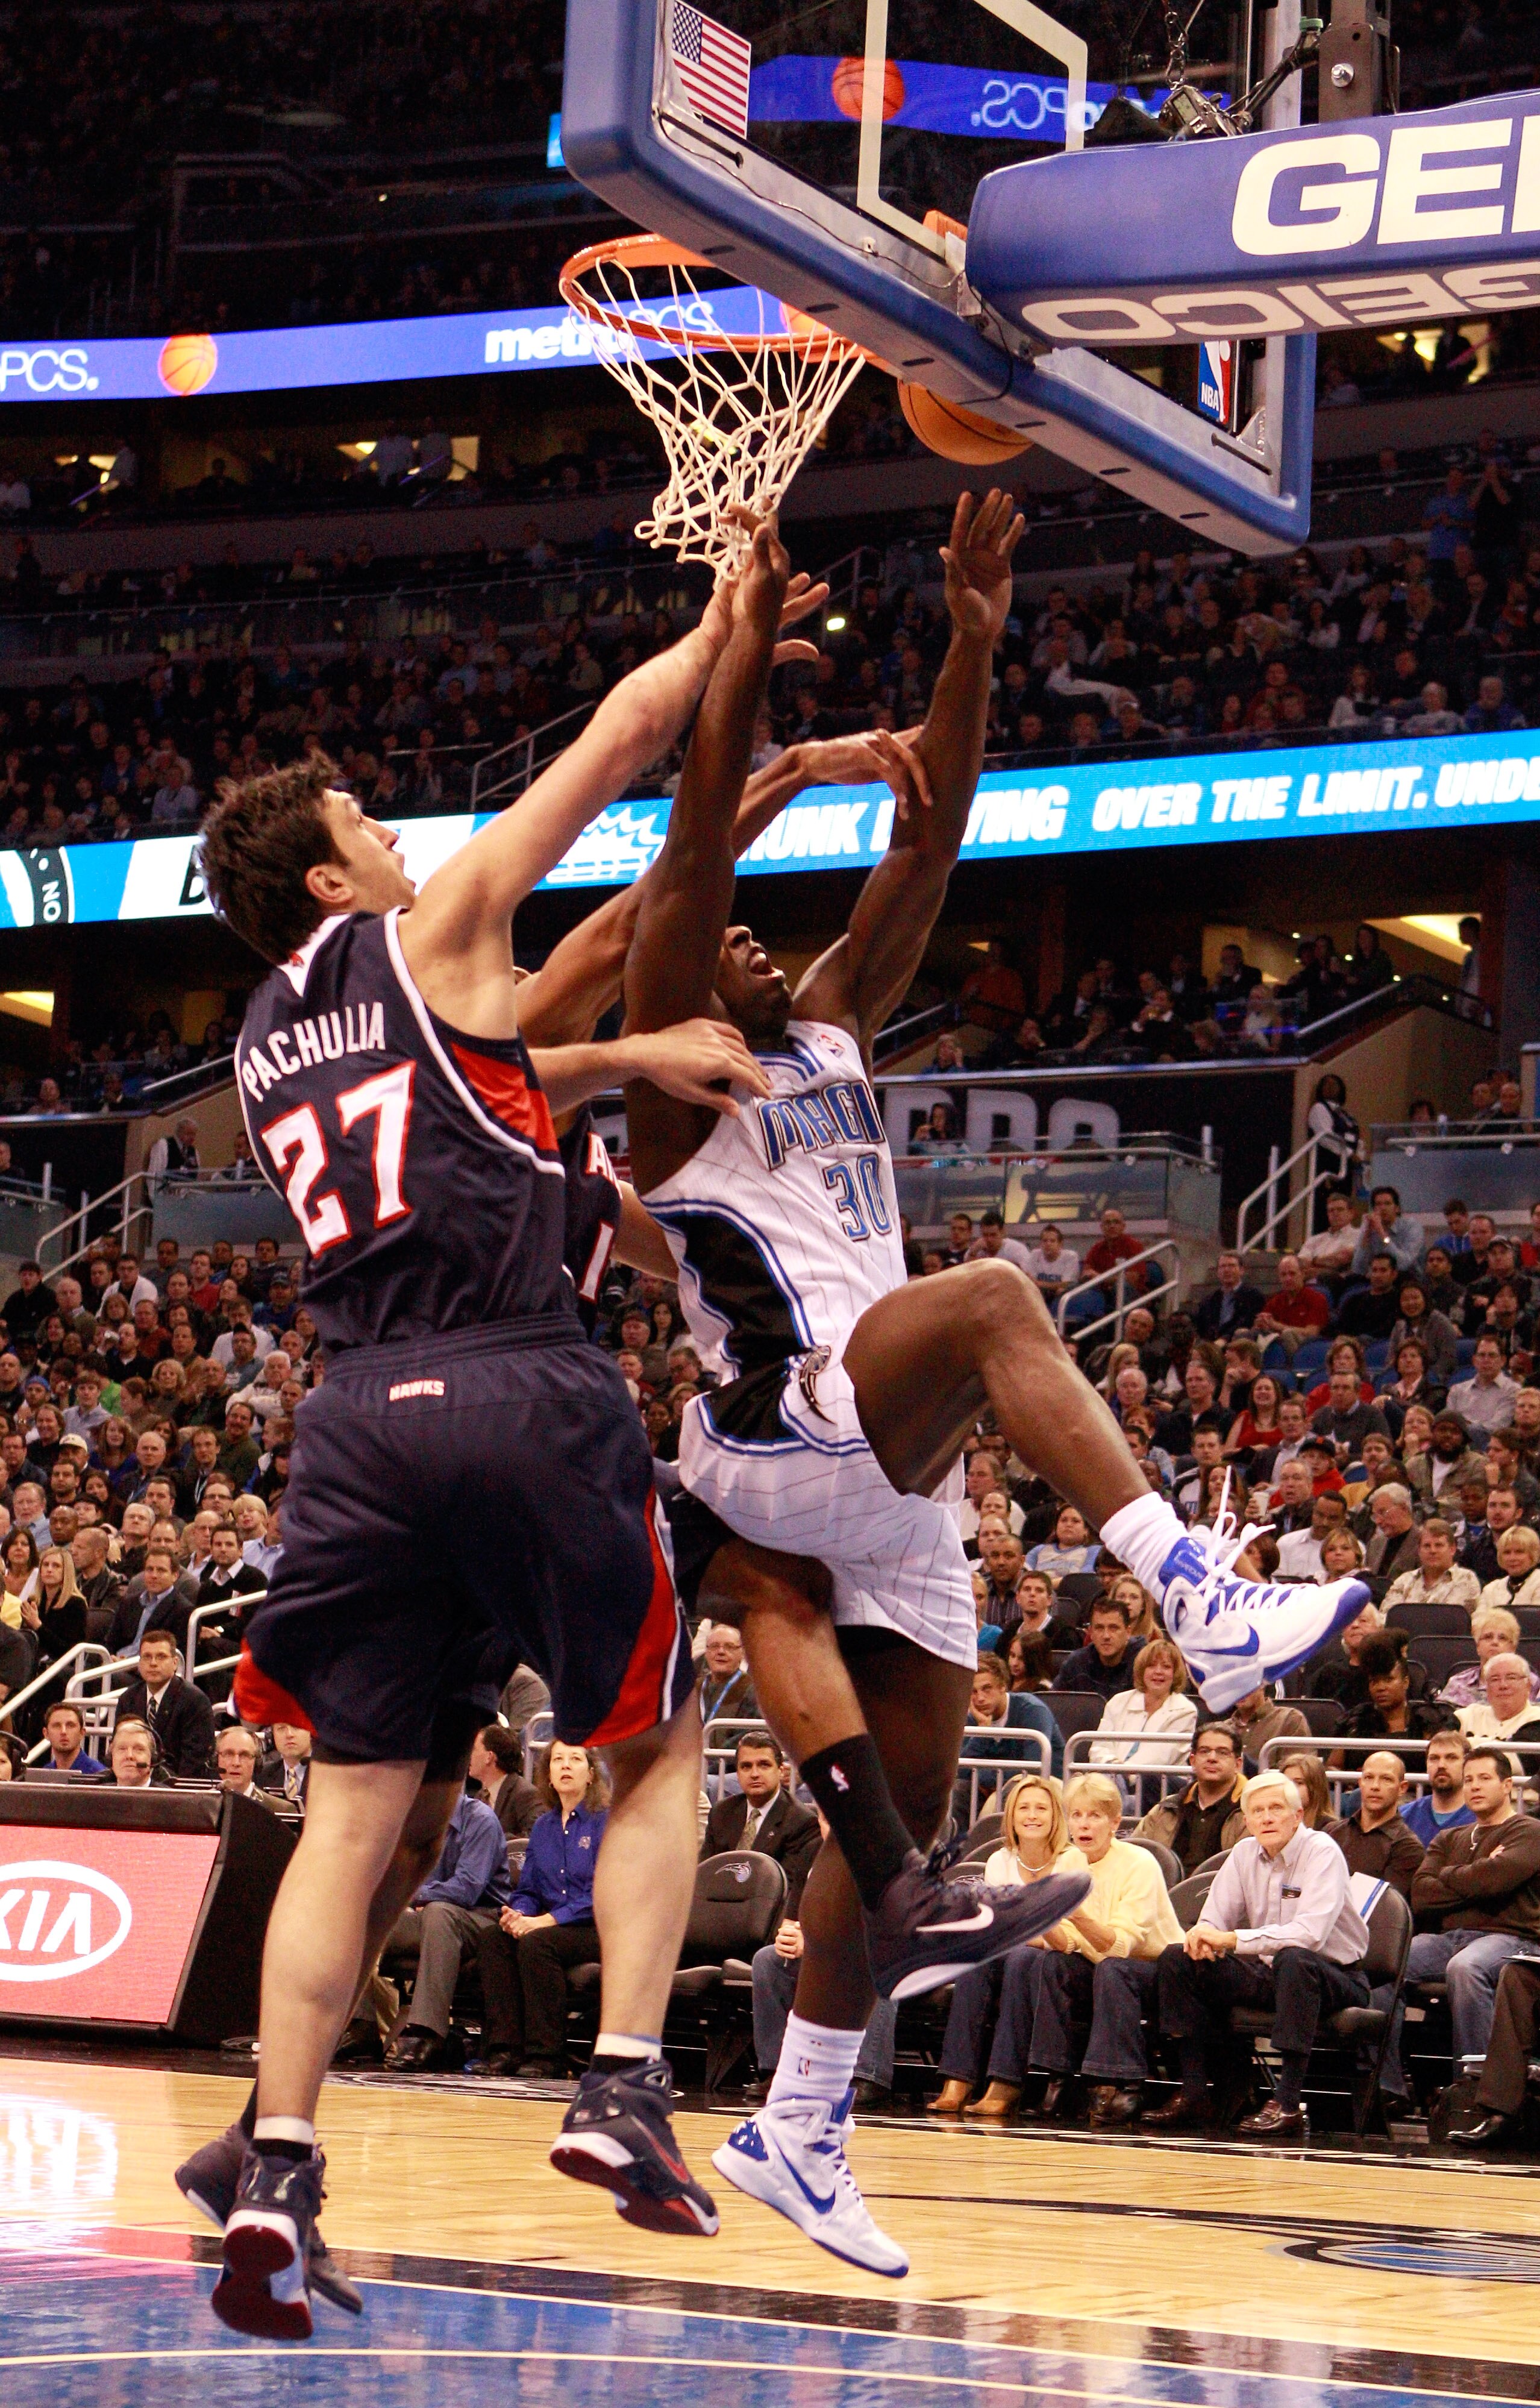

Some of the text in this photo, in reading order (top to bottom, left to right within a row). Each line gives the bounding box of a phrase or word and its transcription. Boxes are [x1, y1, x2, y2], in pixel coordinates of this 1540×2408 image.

[1200, 381, 1219, 412] NBA
[1092, 783, 1203, 832] OVER
[1211, 776, 1292, 823] THE
[1297, 766, 1429, 817] LIMIT.
[242, 1002, 386, 1102] PACHULIA
[260, 1059, 417, 1262] 27
[823, 1152, 892, 1243] 30
[389, 1378, 445, 1402] HAWKS
